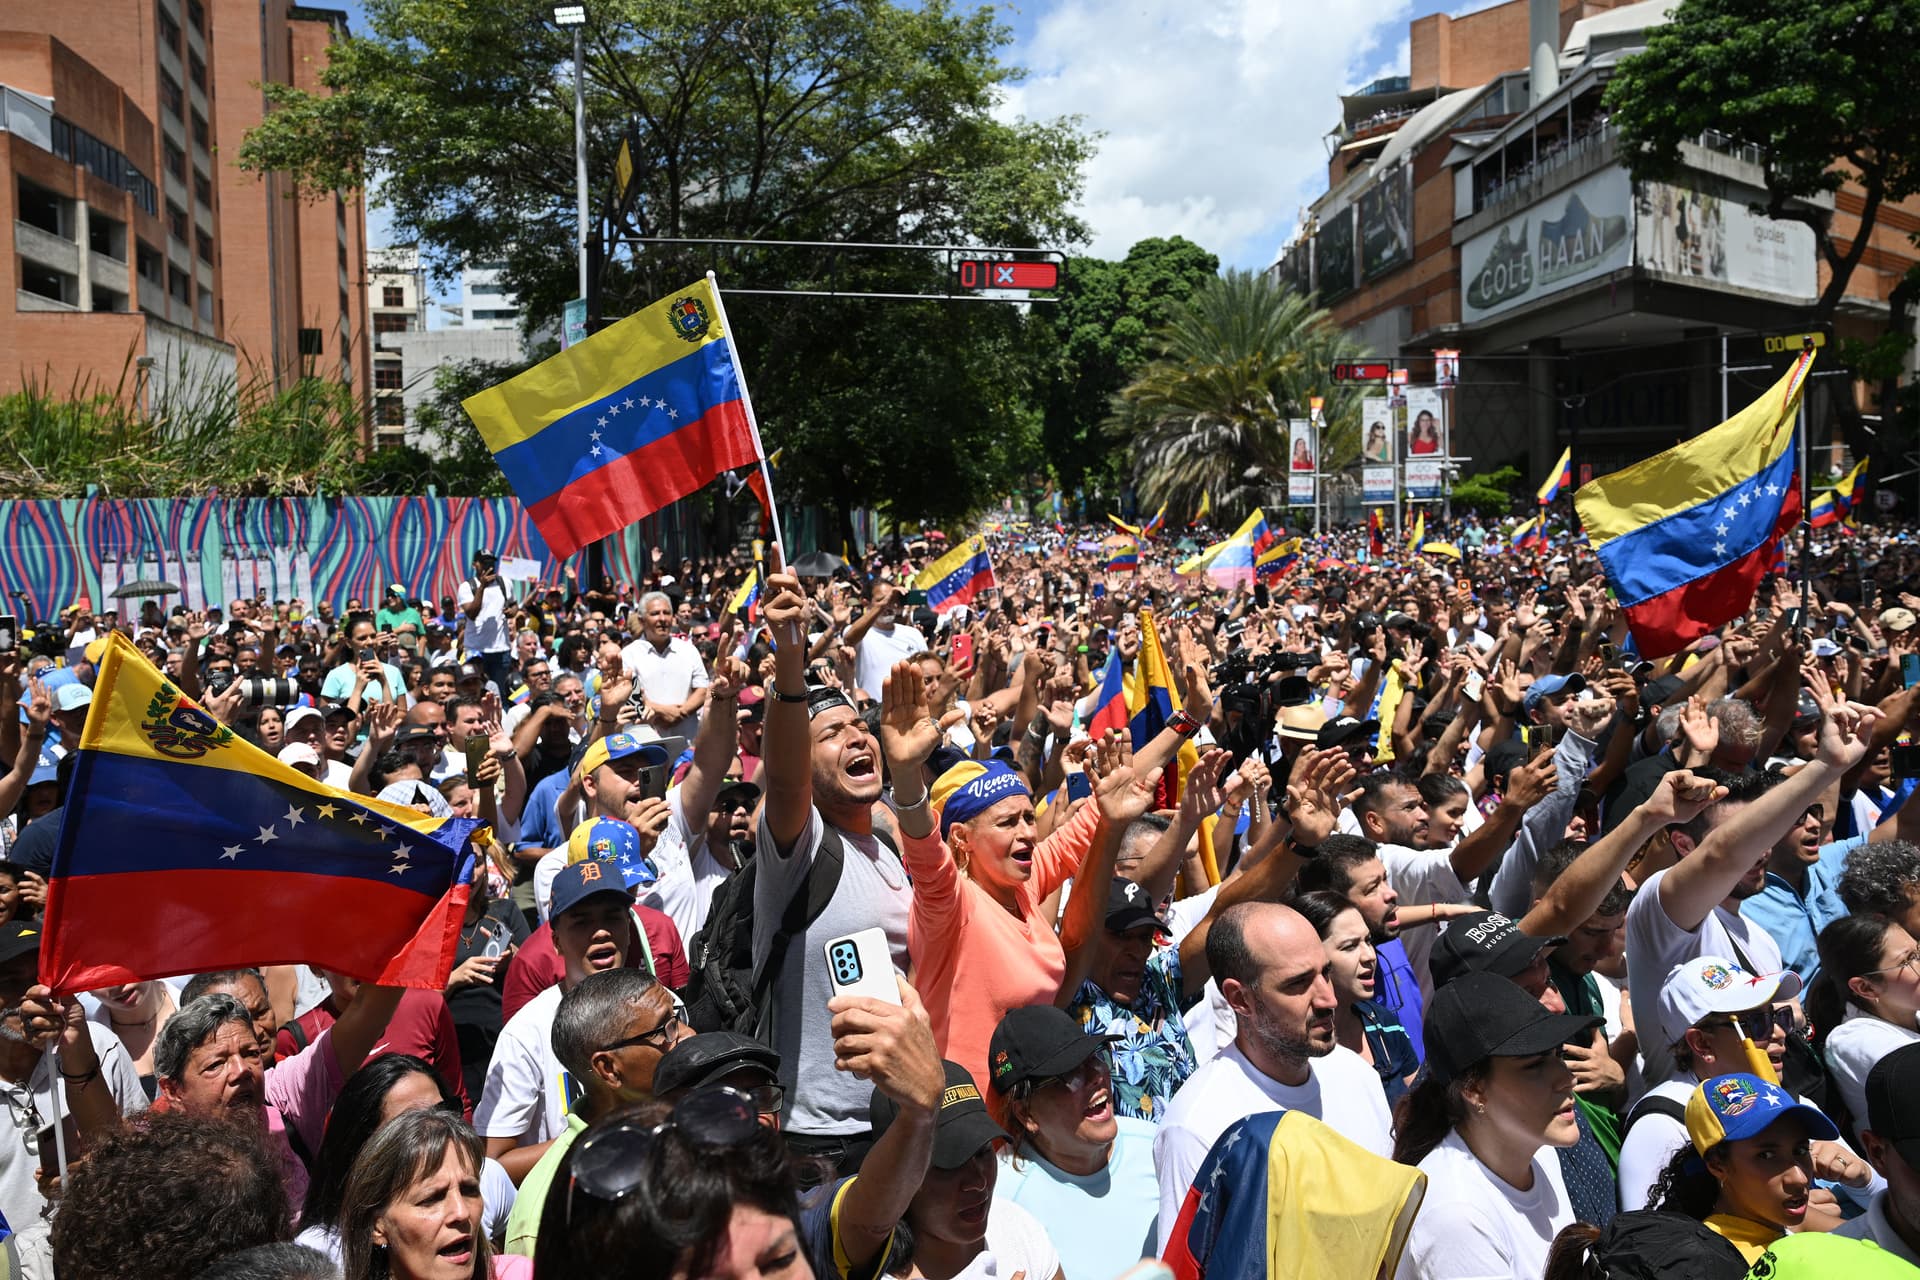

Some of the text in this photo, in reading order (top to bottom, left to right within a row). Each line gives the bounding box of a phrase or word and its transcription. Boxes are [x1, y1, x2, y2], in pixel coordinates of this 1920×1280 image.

[1481, 219, 1605, 300] COLE HAAN
[578, 861, 602, 886] D
[1464, 910, 1512, 944] BOSS
[1485, 931, 1507, 950] HUGO
